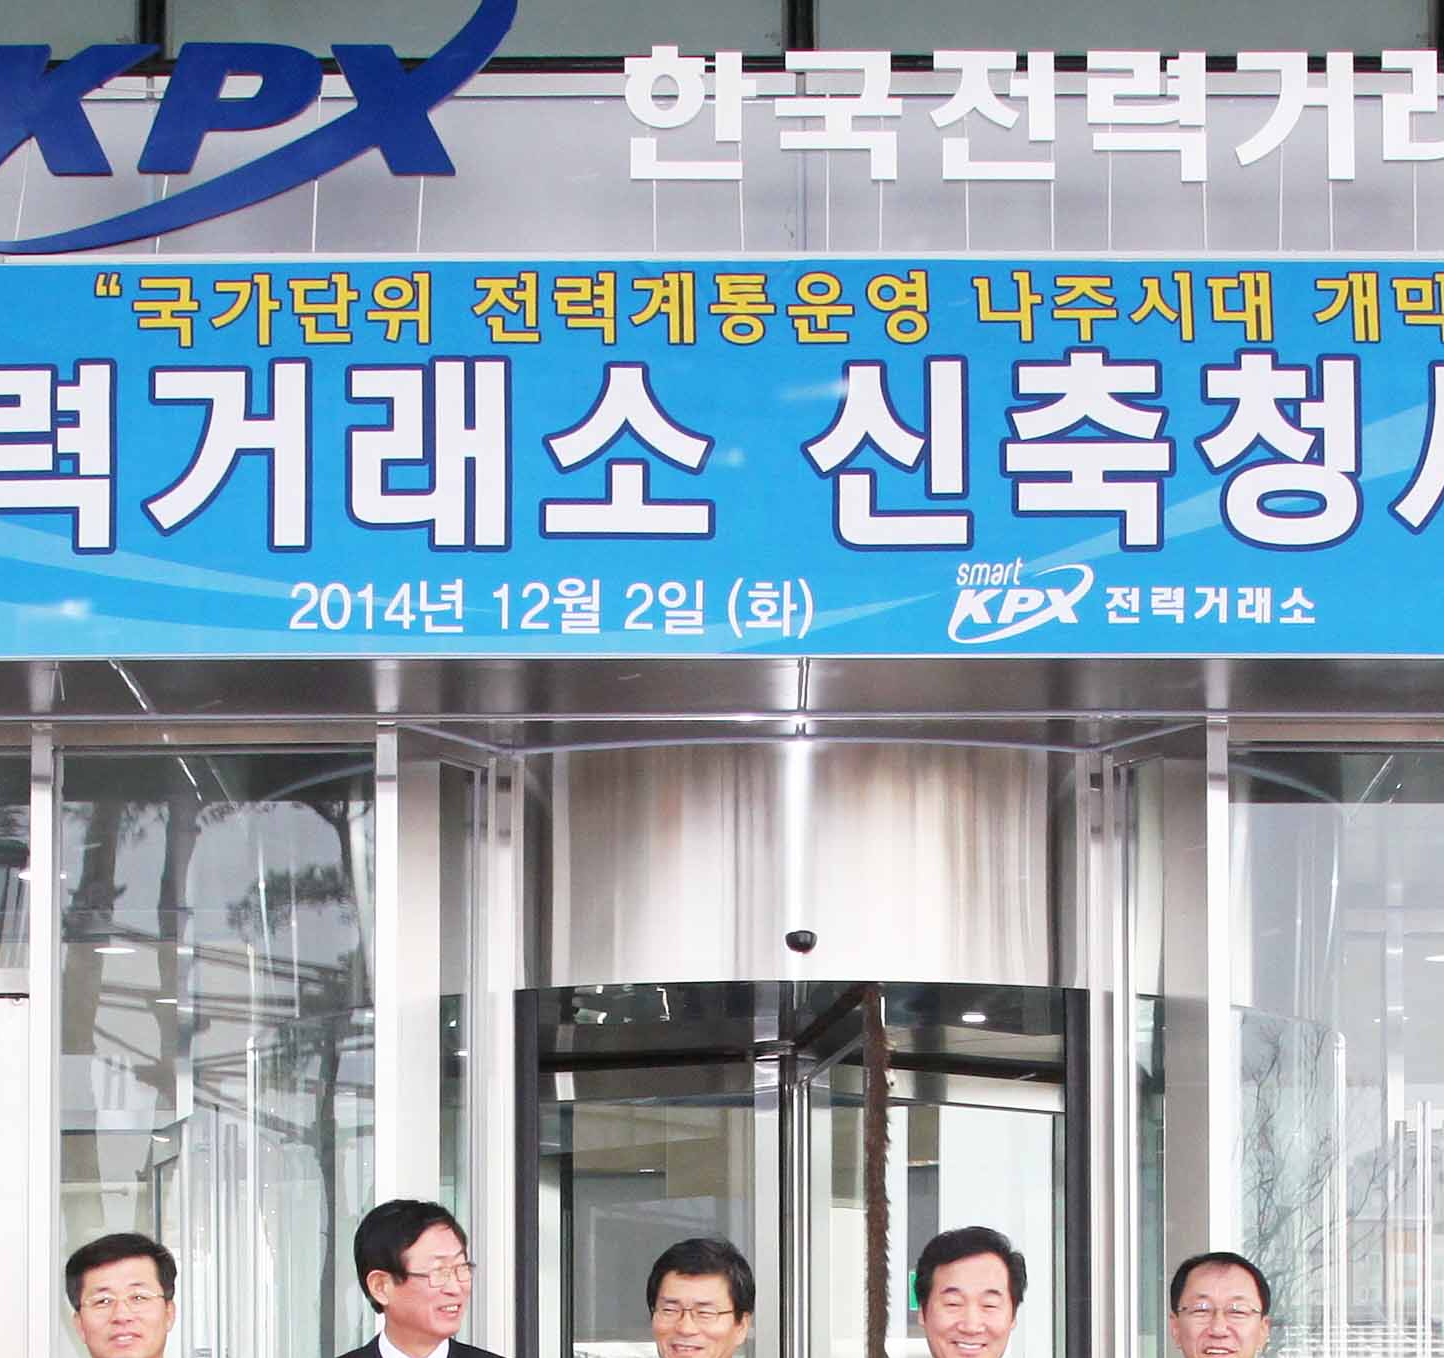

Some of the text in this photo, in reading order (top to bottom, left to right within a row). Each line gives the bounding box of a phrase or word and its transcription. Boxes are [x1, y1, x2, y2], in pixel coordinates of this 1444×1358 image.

[473, 271, 930, 345] 전력계통운영
[972, 270, 1274, 343] 나주시대
[956, 557, 1023, 586] smart
[289, 577, 813, 639] 2014년 12월 2일 (화)
[948, 574, 1093, 630] KPX
[1105, 587, 1316, 625] 전력거래소
